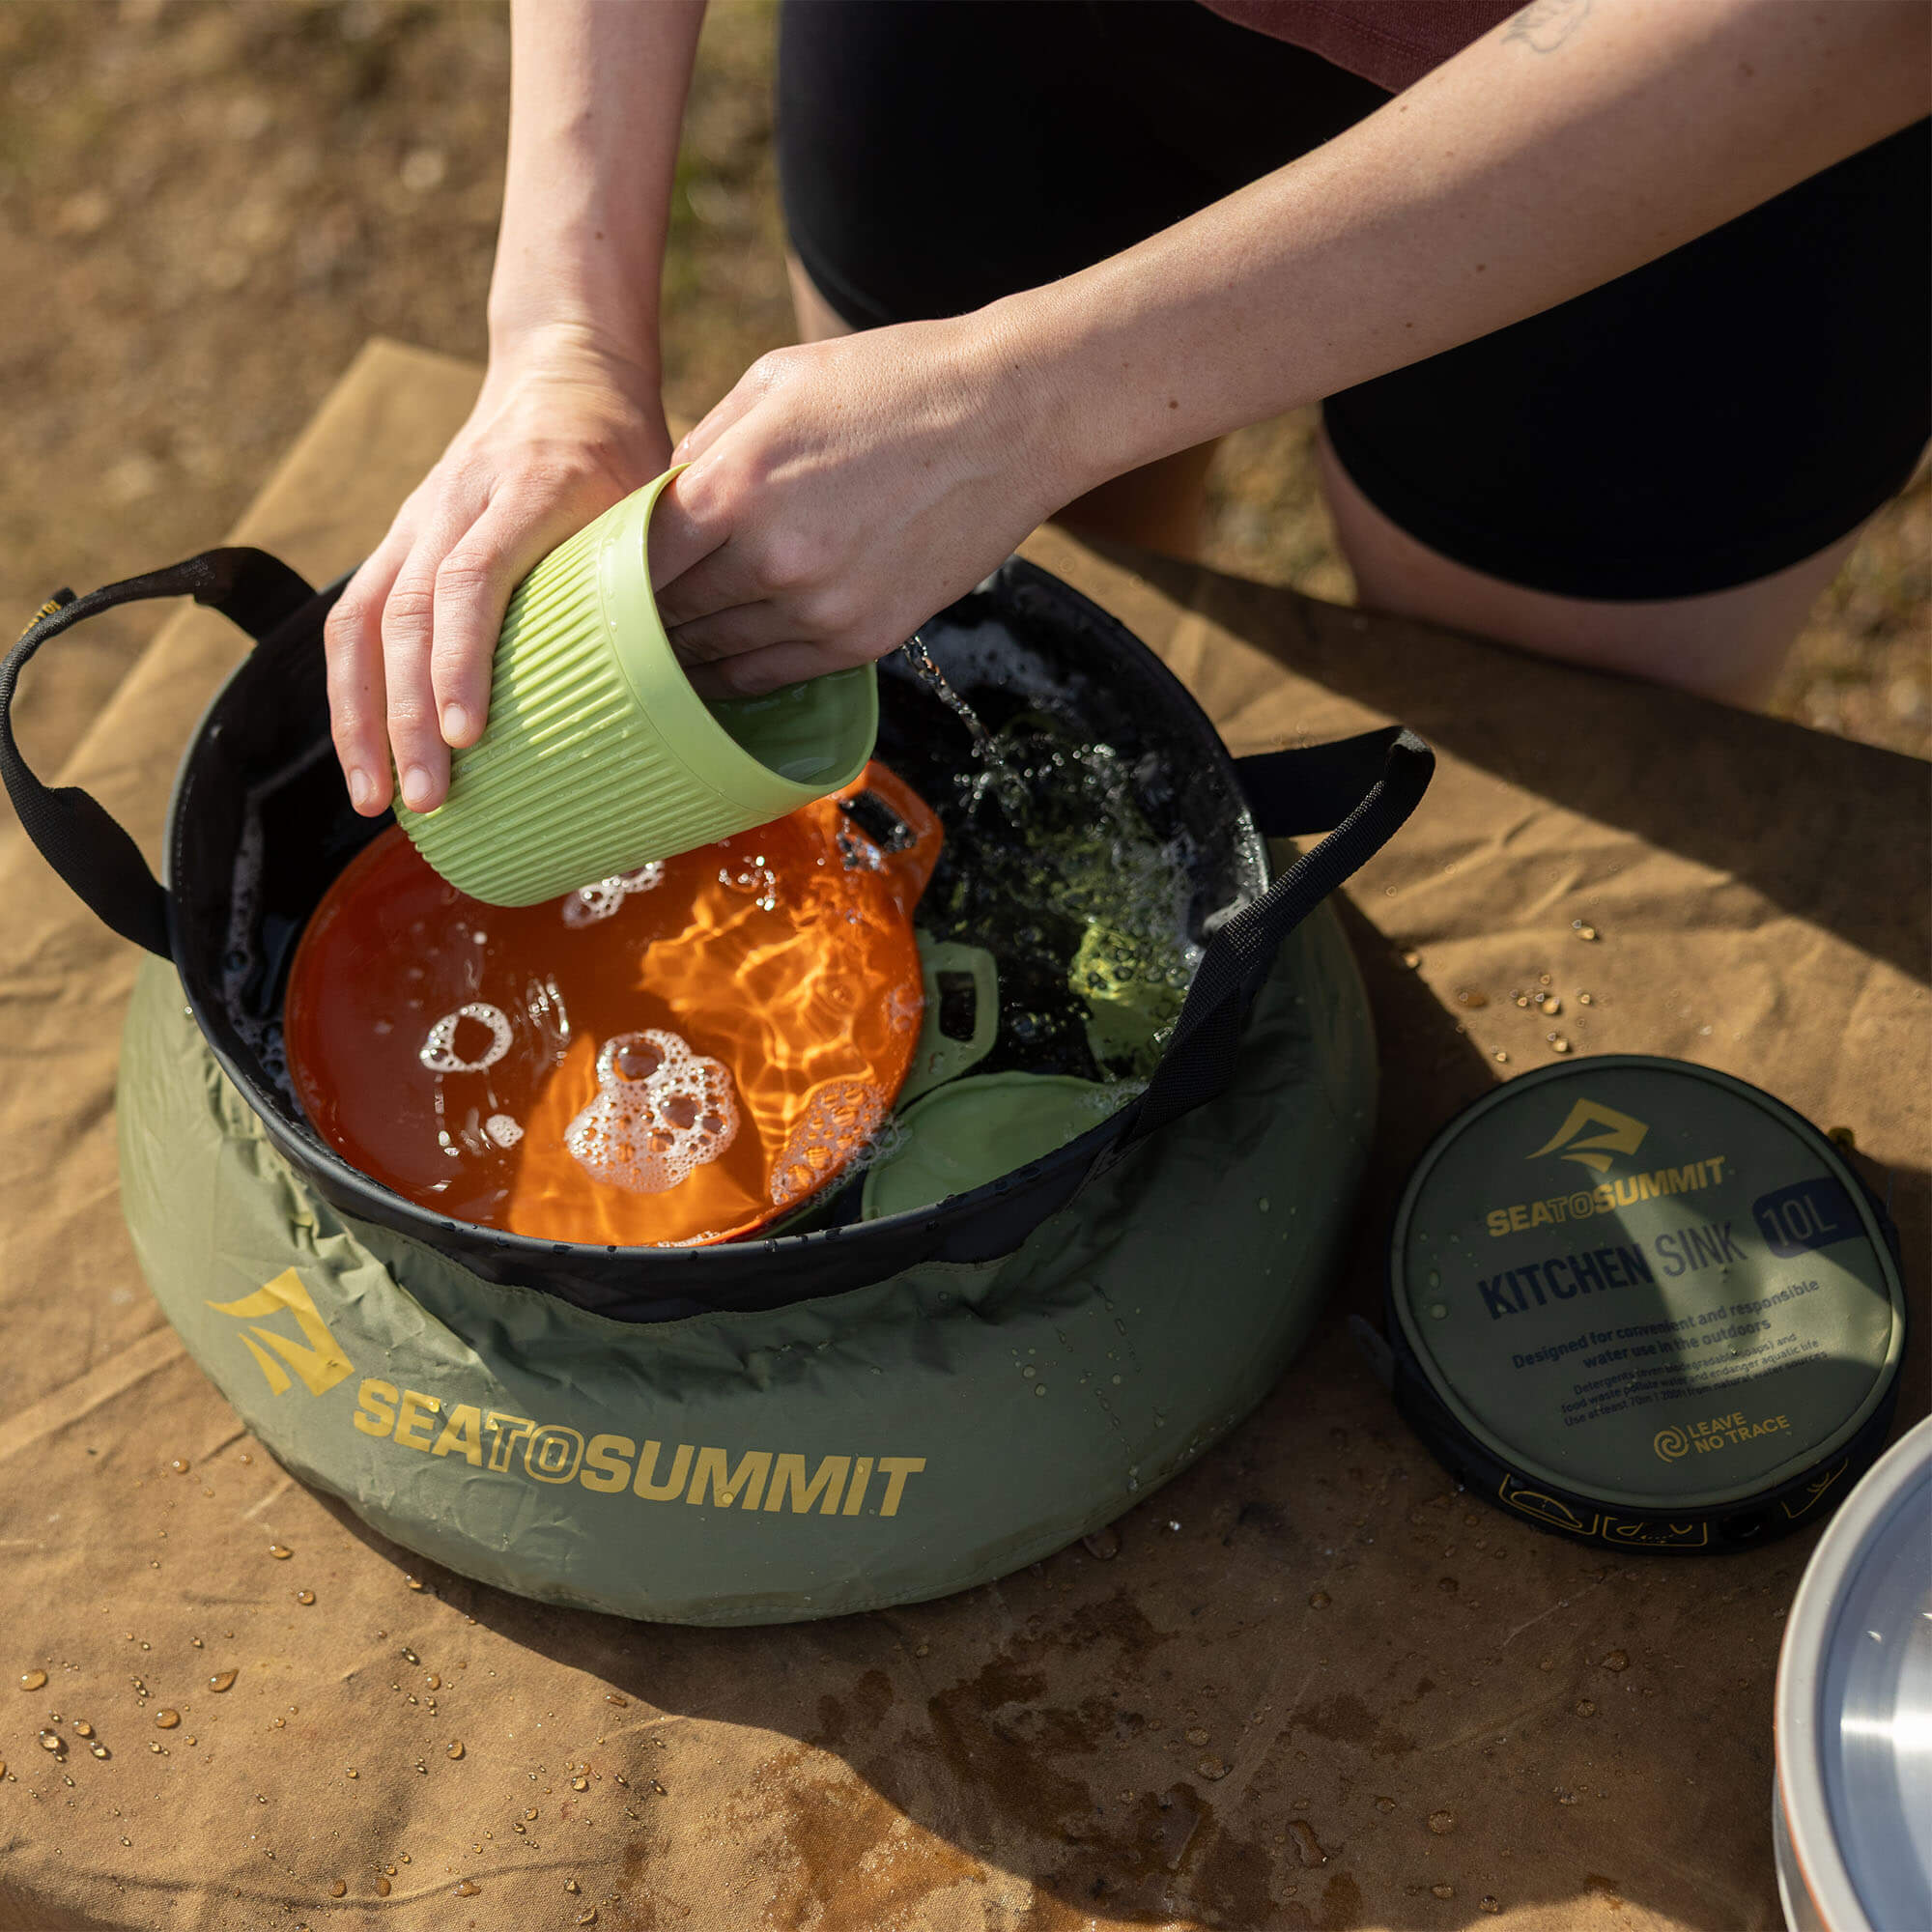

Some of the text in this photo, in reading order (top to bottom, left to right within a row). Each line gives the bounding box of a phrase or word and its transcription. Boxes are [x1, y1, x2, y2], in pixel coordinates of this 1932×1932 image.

[1761, 1194, 1837, 1248] 10L
[1476, 1221, 1748, 1321] KITCHEN SINK
[1511, 1279, 1820, 1370] Designed for convenient and responsible
[1582, 1319, 1772, 1368] water use in the outdoors
[1561, 1398, 1588, 1413] food
[1588, 1388, 1622, 1405] waste
[1709, 1358, 1759, 1378] endanger
[1761, 1344, 1801, 1365] aquatic
[1800, 1338, 1820, 1351] life
[1573, 1371, 1635, 1396] Detergents
[1776, 1332, 1798, 1347] and
[1564, 1413, 1586, 1428] Use
[1687, 1411, 1747, 1438] LEAVE
[1693, 1414, 1791, 1454] NO TRACE
